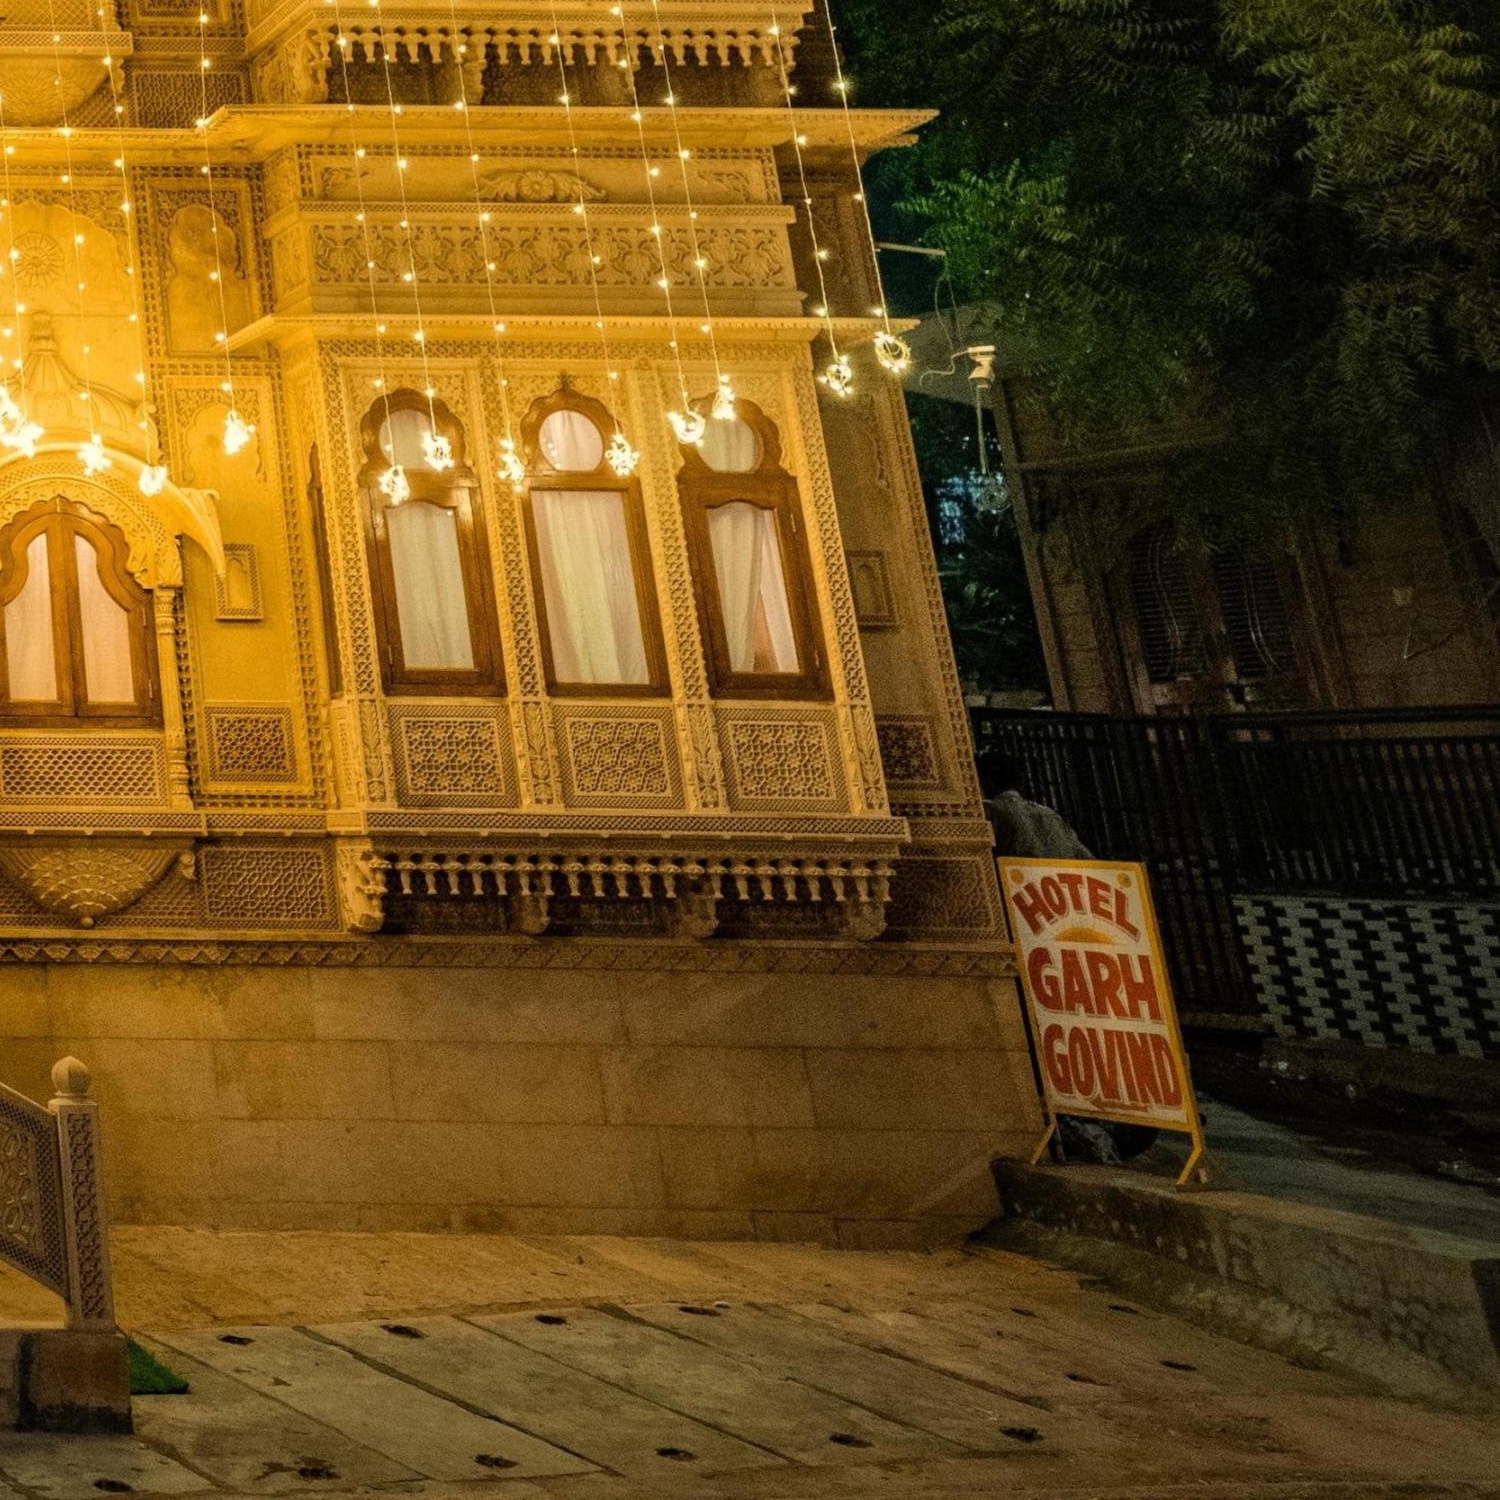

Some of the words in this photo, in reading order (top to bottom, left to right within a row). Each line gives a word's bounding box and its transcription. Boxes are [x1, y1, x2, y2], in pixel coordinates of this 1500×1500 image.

[1012, 872, 1141, 941] HOTEL
[1027, 947, 1164, 1025] GARH
[1043, 1023, 1183, 1110] GOVIND
